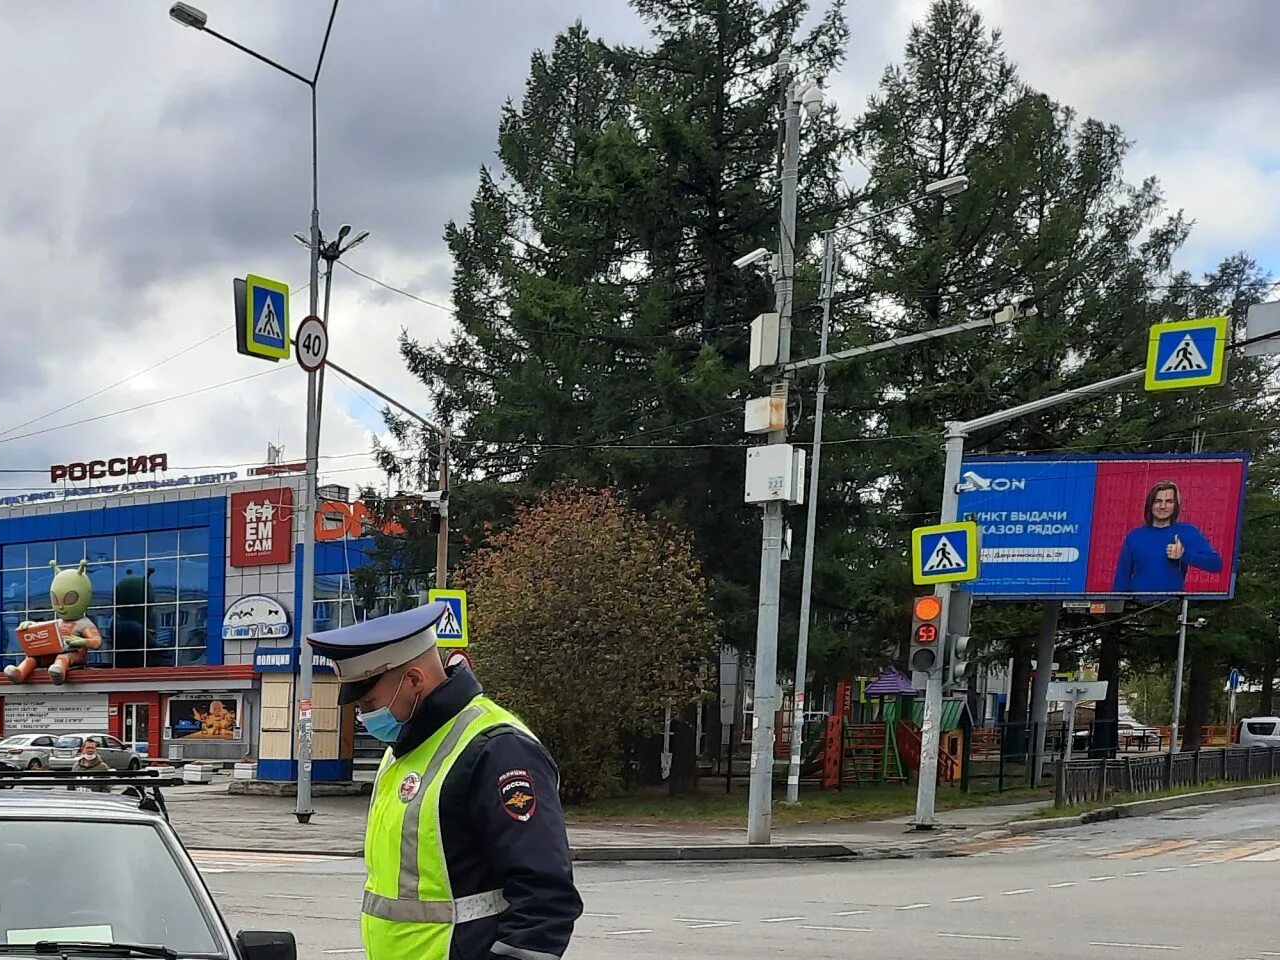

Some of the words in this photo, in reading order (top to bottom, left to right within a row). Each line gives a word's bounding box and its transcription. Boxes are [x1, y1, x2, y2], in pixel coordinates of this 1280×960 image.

[302, 333, 321, 357] 40
[51, 453, 168, 483] РОССИЯ
[768, 480, 784, 489] 221
[1010, 511, 1067, 523] ВЫДАЧИ
[1027, 523, 1079, 535] РЯДОМ!
[23, 630, 49, 642] DNS
[917, 626, 936, 641] 53
[256, 654, 290, 667] ПОЛИЦИЯ
